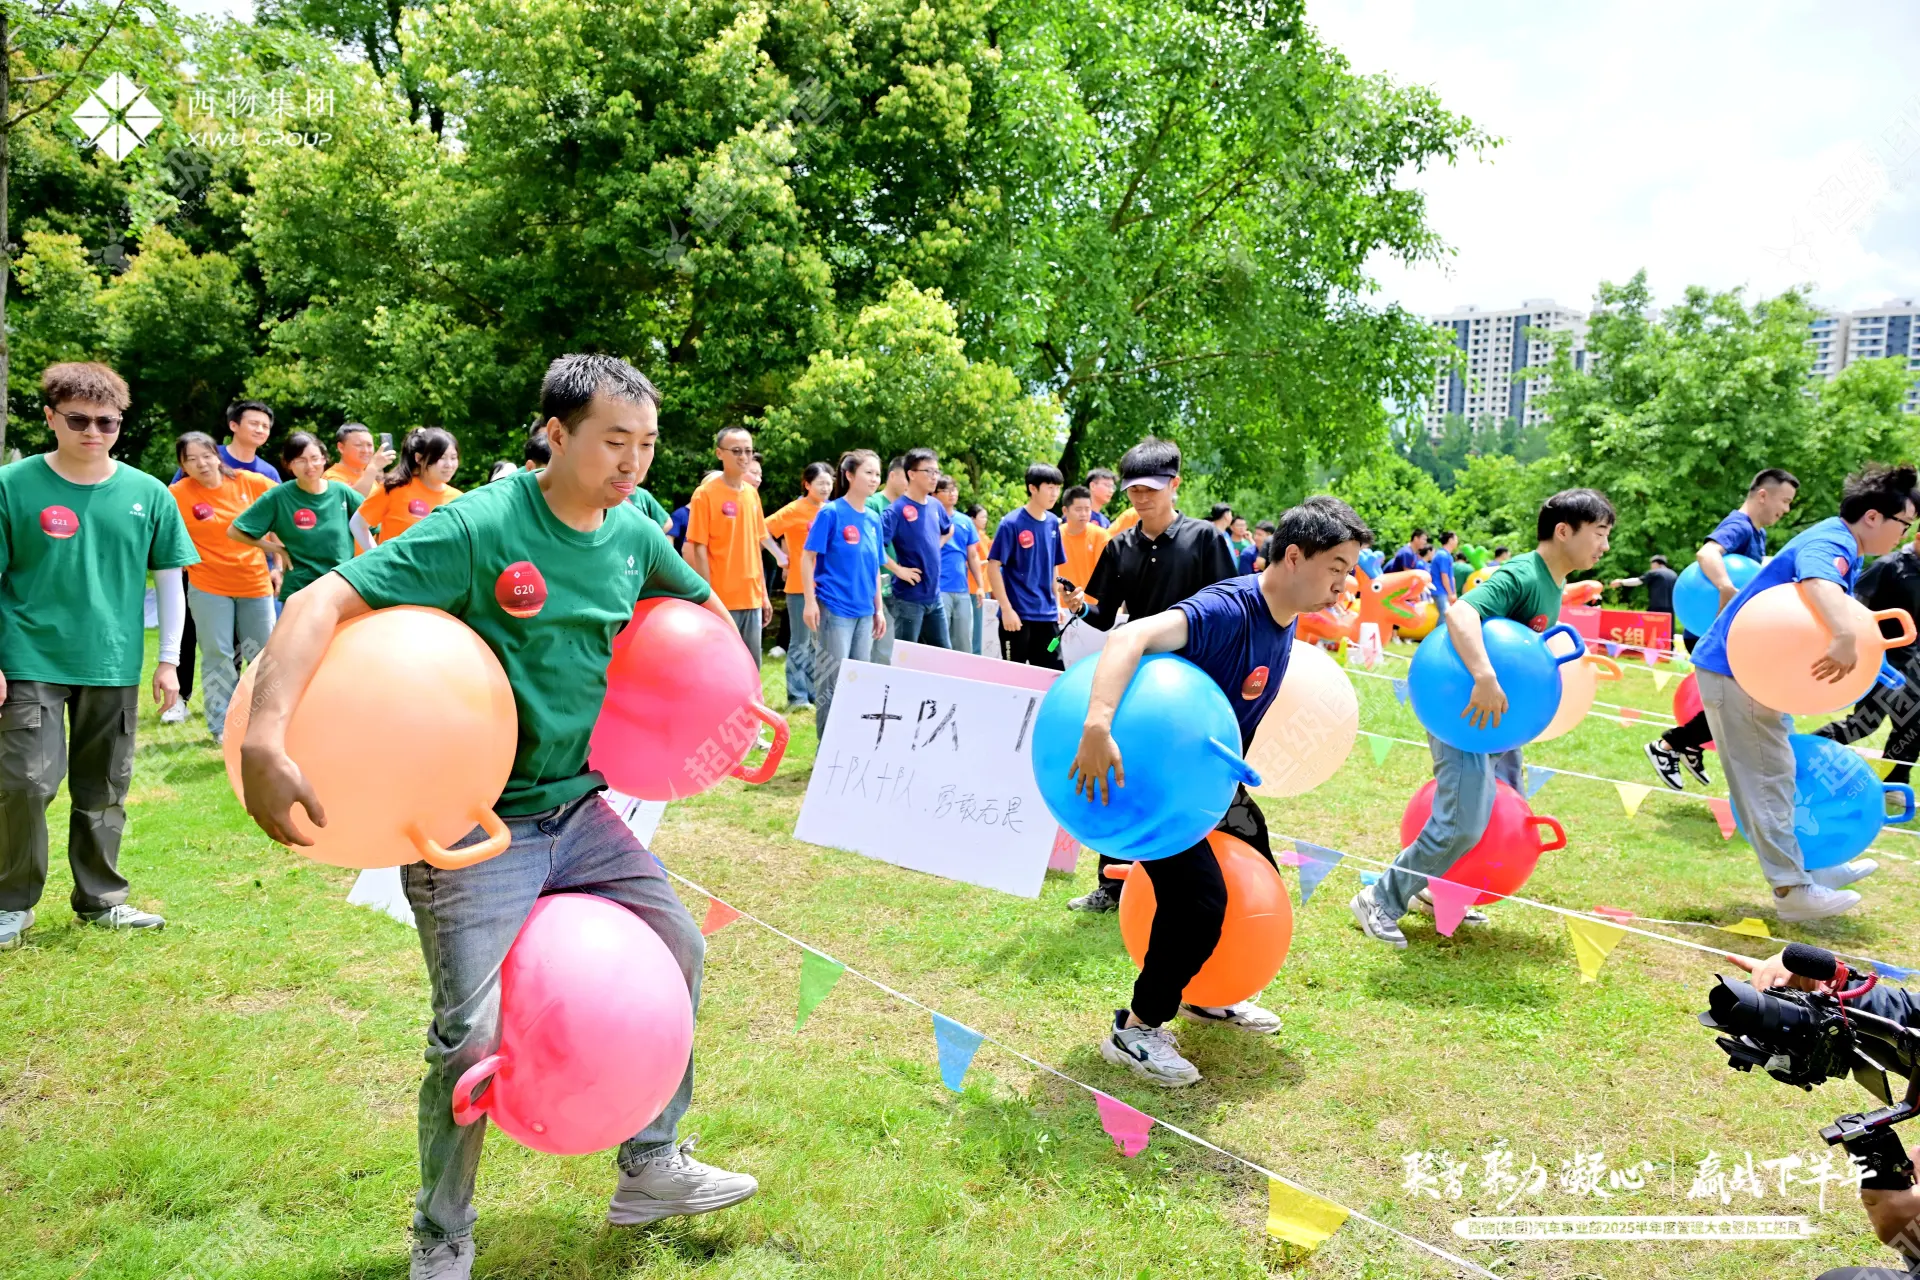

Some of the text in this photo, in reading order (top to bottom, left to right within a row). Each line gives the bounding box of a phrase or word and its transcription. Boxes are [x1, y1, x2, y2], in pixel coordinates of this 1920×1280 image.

[51, 517, 68, 526] G21
[513, 583, 535, 596] G20
[1609, 626, 1646, 648] S组
